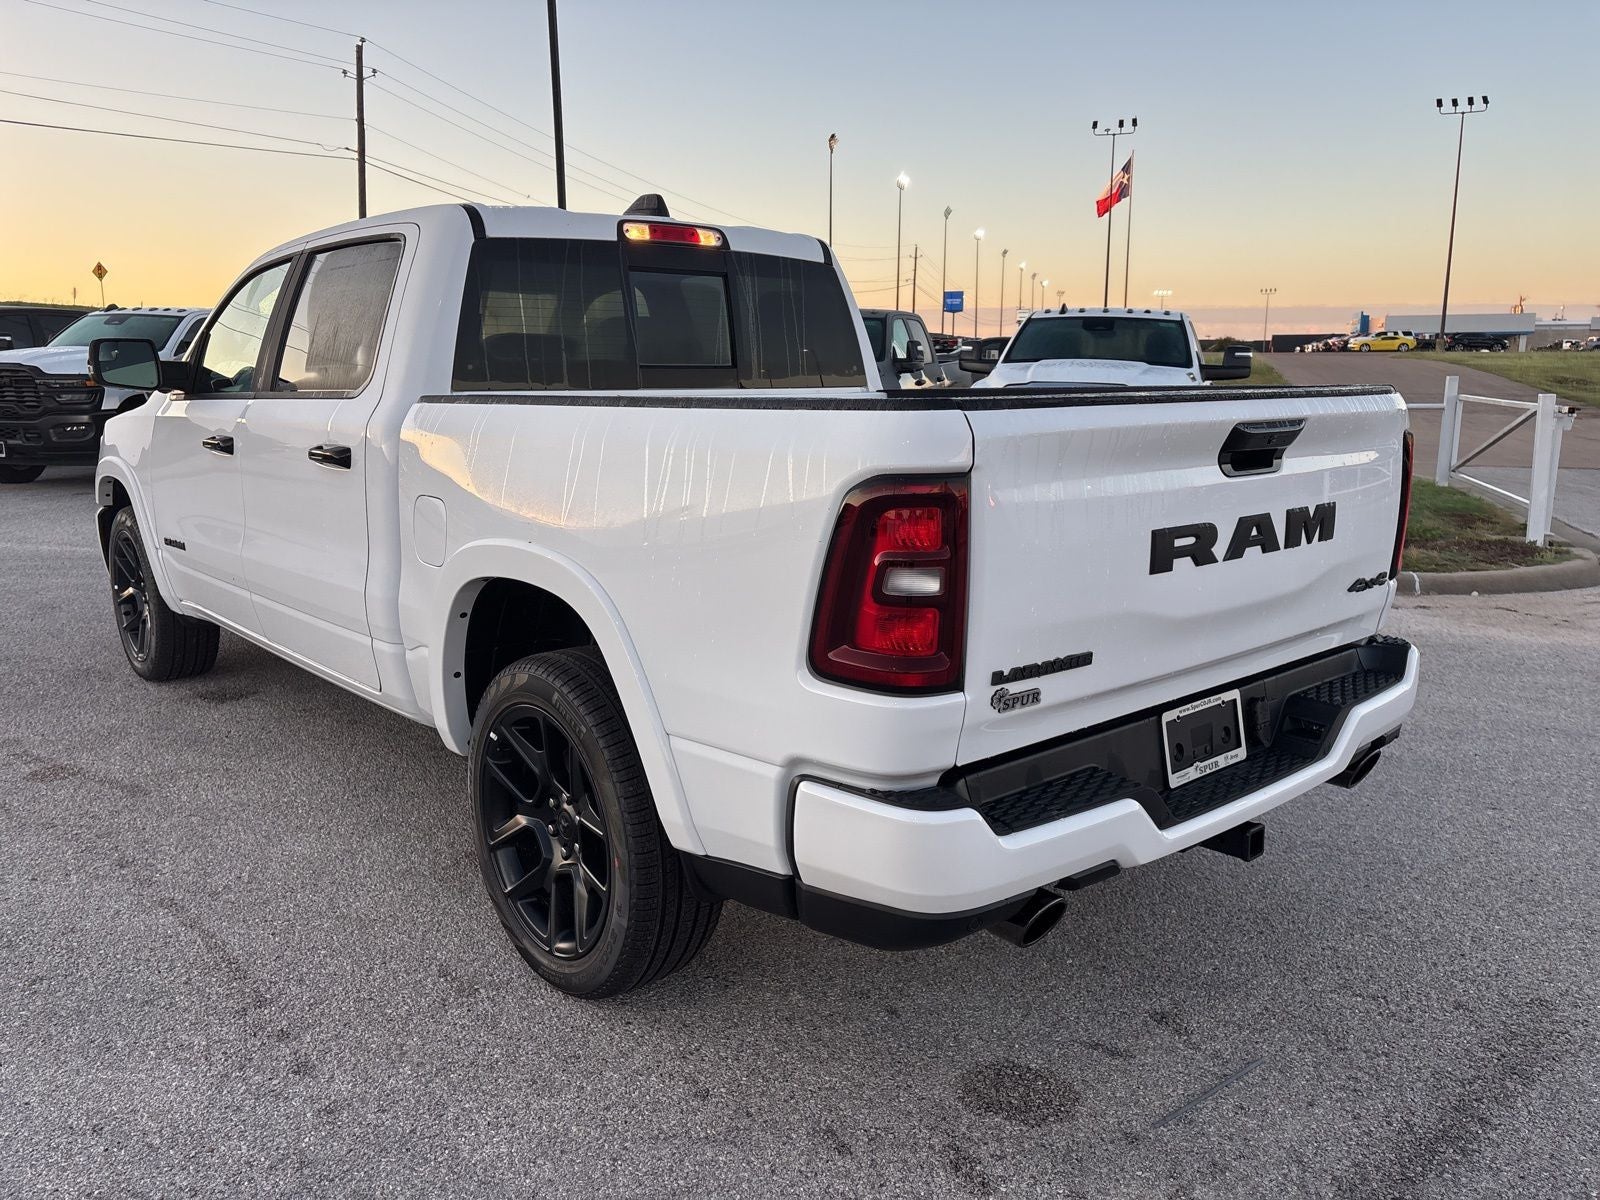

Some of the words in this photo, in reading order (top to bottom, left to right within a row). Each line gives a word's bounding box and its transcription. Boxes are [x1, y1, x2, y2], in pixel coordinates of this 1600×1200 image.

[1149, 501, 1336, 575] RAM
[990, 651, 1094, 686] LARAMIE
[1003, 691, 1040, 711] SPUR
[1198, 760, 1220, 775] SPUR
